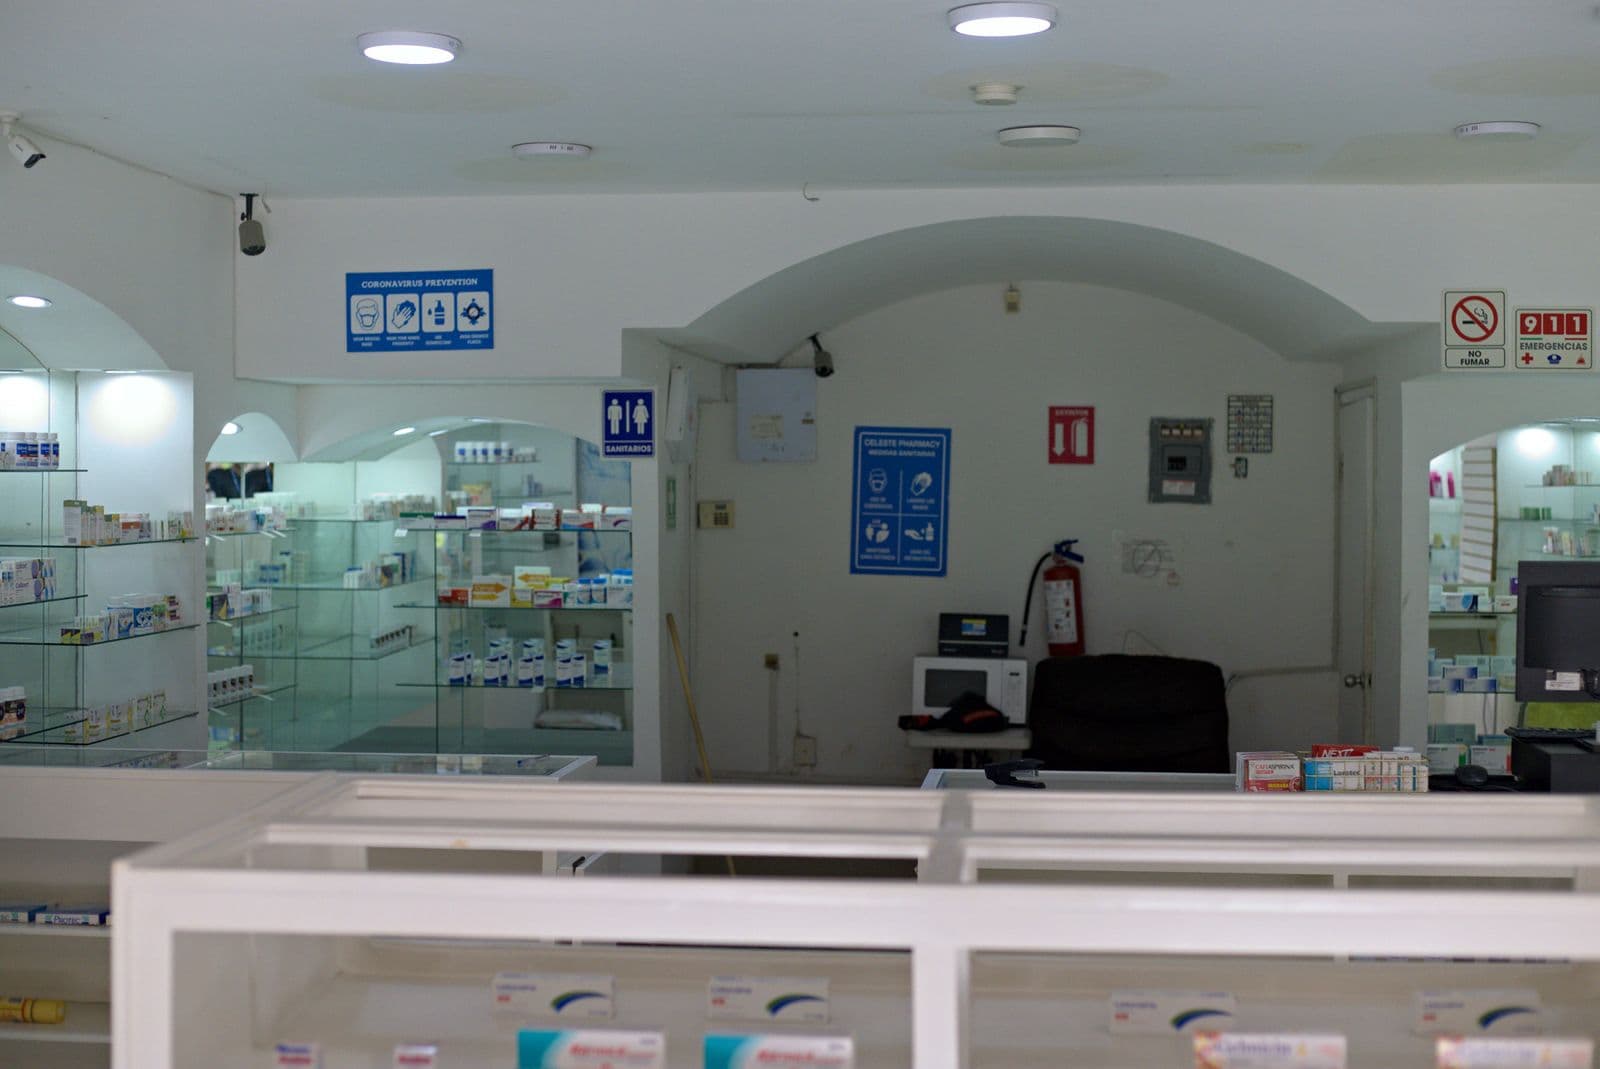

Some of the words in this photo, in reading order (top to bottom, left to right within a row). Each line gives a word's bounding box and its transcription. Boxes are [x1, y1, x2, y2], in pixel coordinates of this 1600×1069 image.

[361, 279, 423, 289] CORONAVIRUS
[425, 278, 478, 287] PREVENTION
[1524, 315, 1580, 333] 911
[1519, 342, 1588, 351] EMERGENCIAS
[1468, 350, 1482, 358] NO
[1460, 358, 1490, 366] FUMAR
[606, 445, 652, 453] SANITARIOS
